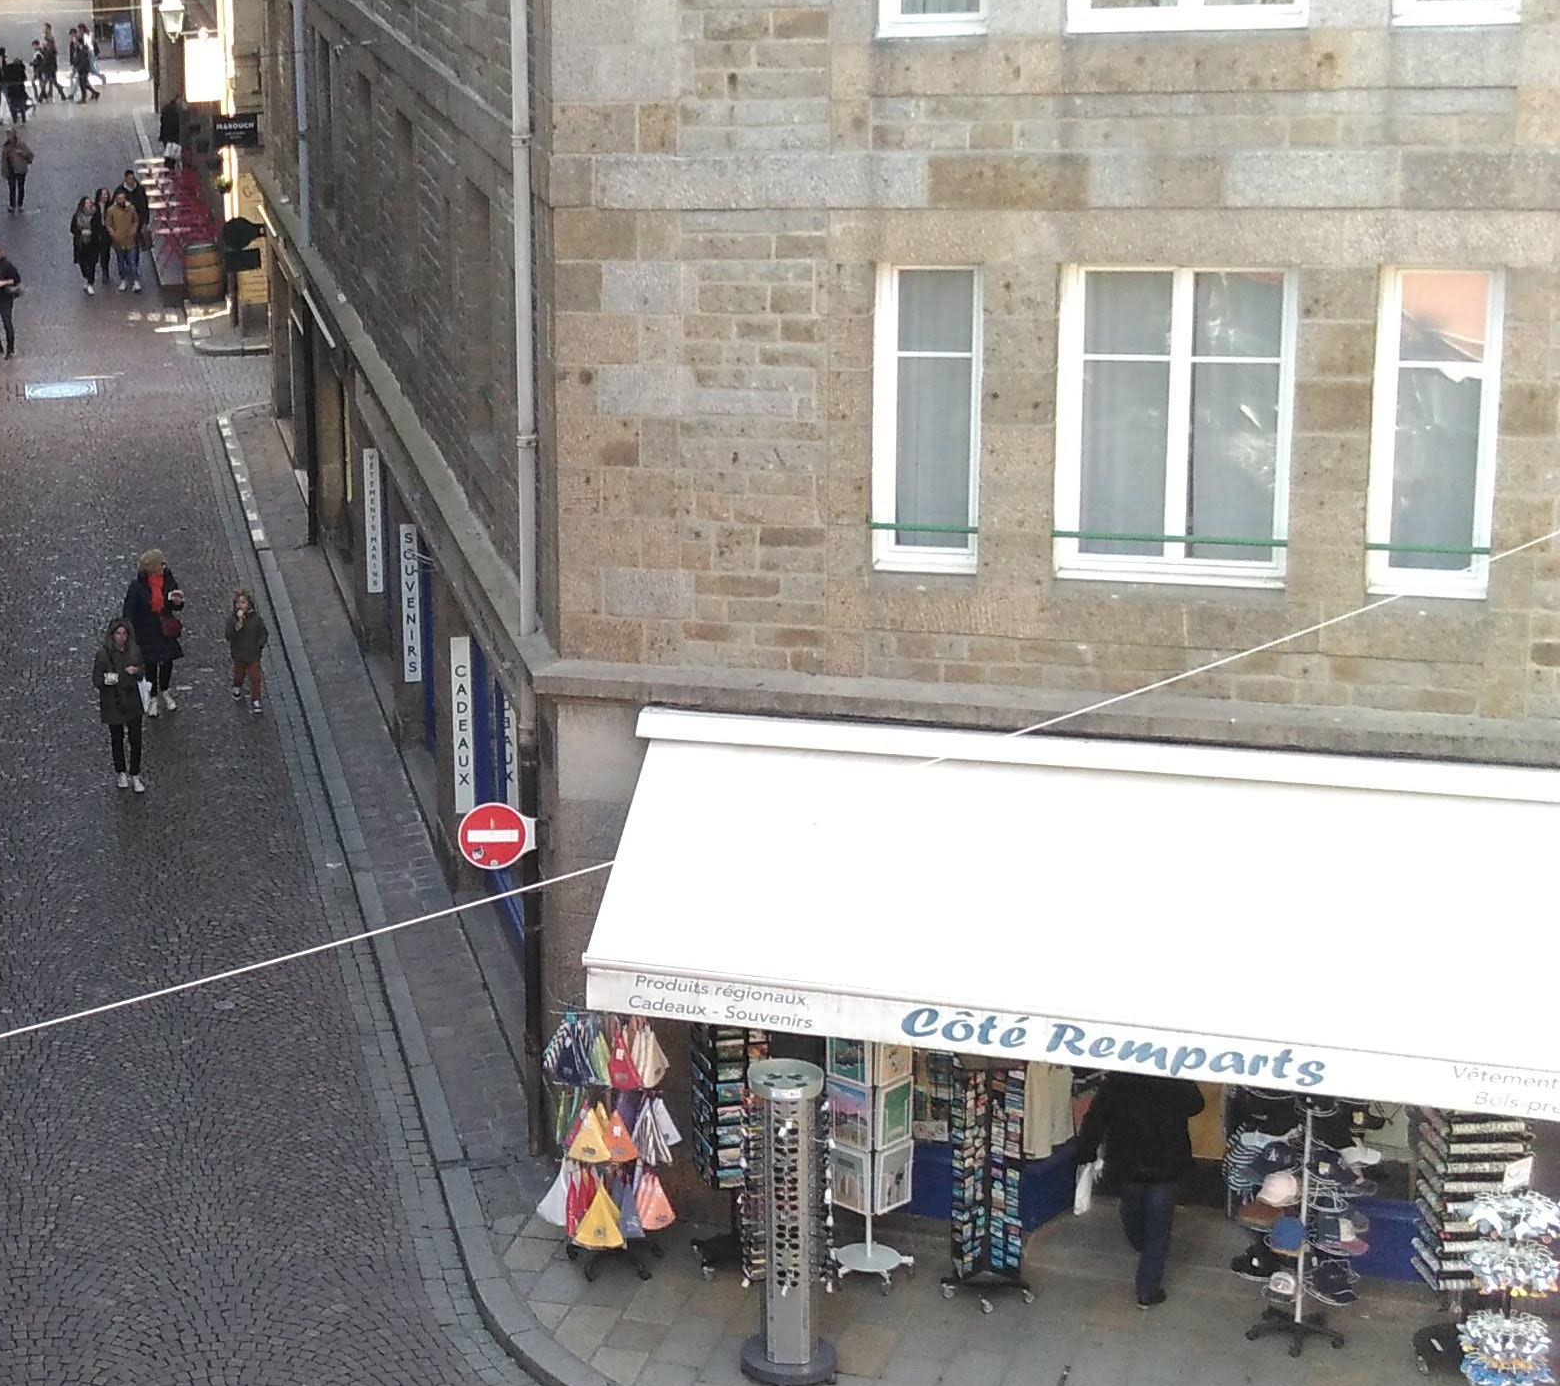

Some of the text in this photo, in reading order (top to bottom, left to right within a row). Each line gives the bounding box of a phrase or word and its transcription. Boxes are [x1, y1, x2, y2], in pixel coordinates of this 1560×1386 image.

[370, 536, 378, 587] MARINS
[403, 531, 418, 674] SOUVENIRS
[453, 663, 470, 786] CADEAUX
[628, 994, 706, 1016] Cadeaux
[724, 1005, 813, 1029] Souvenirs
[635, 975, 807, 1007] Produits régionaux
[901, 1007, 1326, 1087] Côté Remparts
